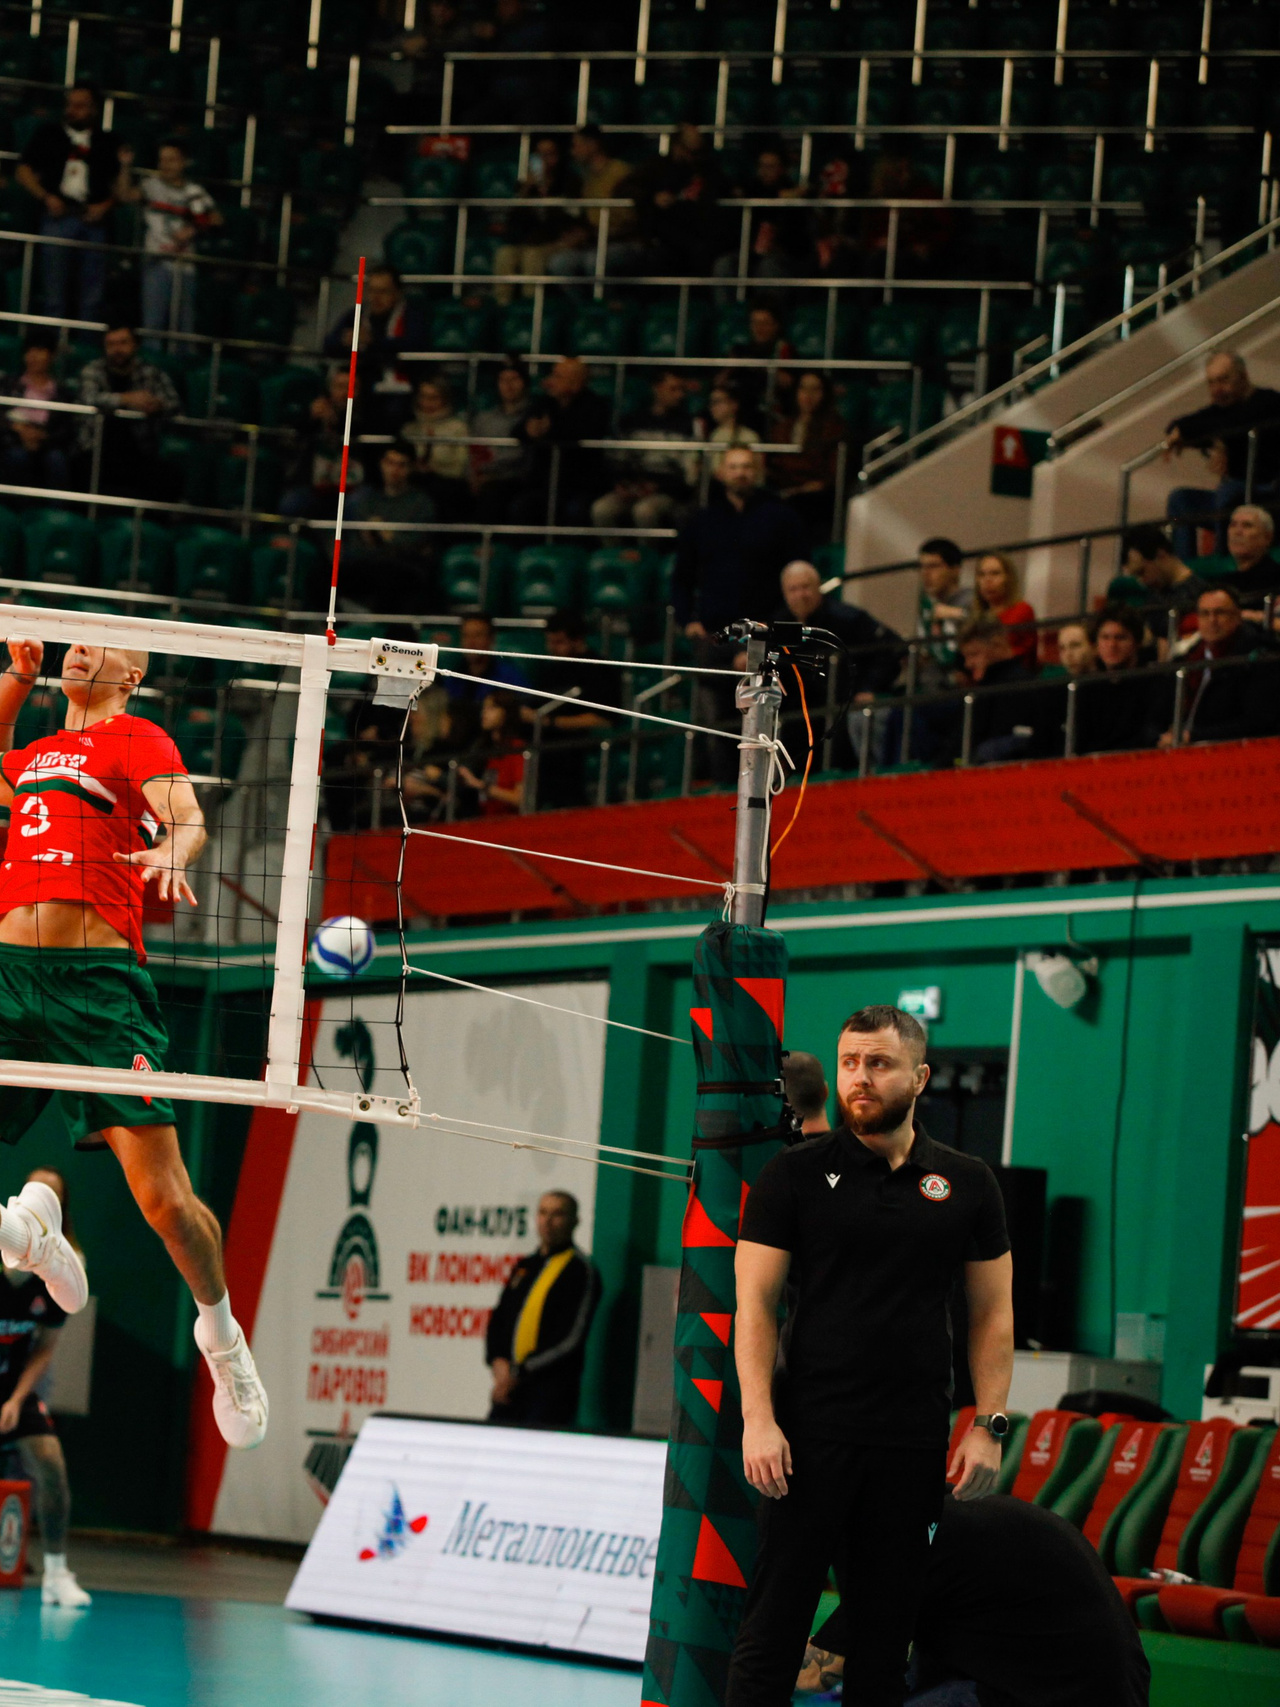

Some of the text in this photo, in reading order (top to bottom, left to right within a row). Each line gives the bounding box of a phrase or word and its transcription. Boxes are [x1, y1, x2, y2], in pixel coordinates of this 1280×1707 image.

[391, 645, 424, 657] Senoh
[21, 795, 51, 838] 3
[434, 1204, 529, 1237] ФАН-КЛУБ
[407, 1252, 430, 1283] ВК
[311, 1323, 390, 1358] СИБИРСКИЙ
[307, 1363, 388, 1405] ПАРОВОЗ
